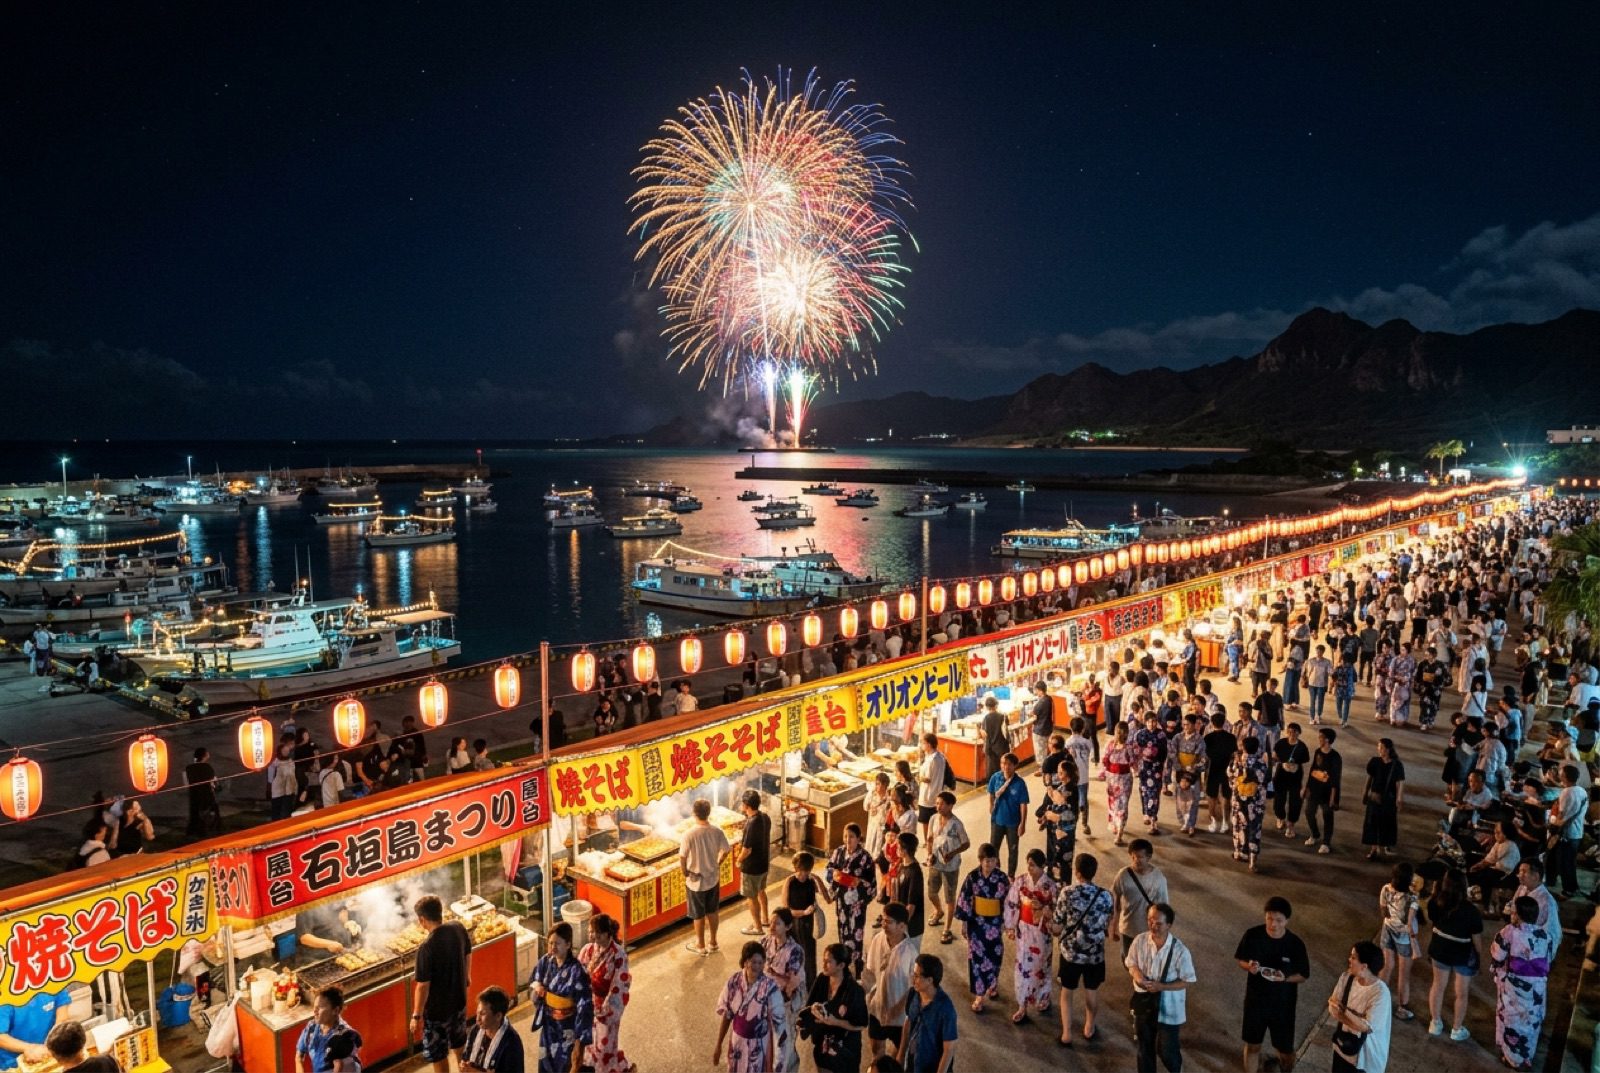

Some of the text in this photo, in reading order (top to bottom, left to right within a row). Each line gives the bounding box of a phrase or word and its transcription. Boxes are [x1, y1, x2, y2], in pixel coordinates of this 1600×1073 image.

[866, 661, 963, 720] オリオンビール
[522, 777, 540, 824] 屋台
[556, 755, 634, 808] 焼そば
[300, 790, 517, 892] 石垣島まつり
[266, 849, 295, 907] 屋台
[0, 876, 178, 995] 焼そば
